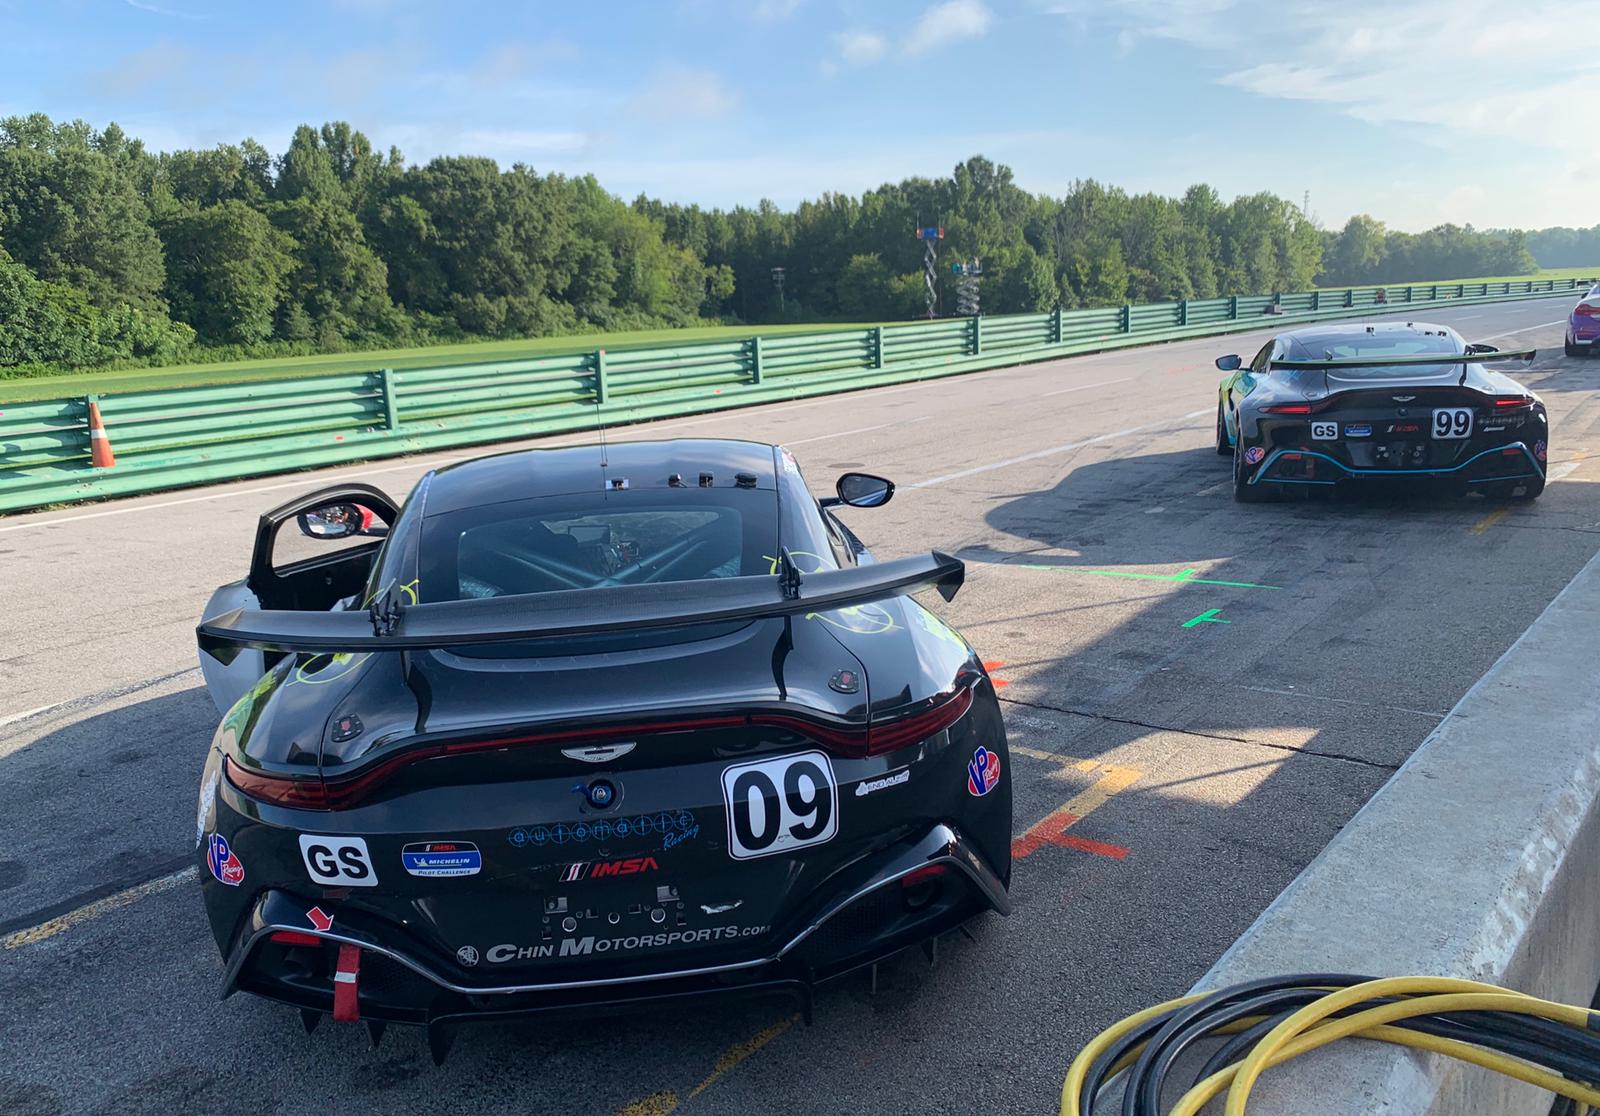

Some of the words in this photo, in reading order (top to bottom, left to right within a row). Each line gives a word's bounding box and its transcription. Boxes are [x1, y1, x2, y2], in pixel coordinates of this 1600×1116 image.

[1313, 425, 1336, 437] GS
[1436, 410, 1470, 437] 99
[732, 760, 833, 851] 09
[511, 811, 693, 846] automatic
[663, 824, 701, 851] Racing
[307, 844, 370, 880] GS
[428, 858, 471, 866] MICHELIN
[590, 857, 659, 879] IMSA
[486, 943, 554, 964] CHIN
